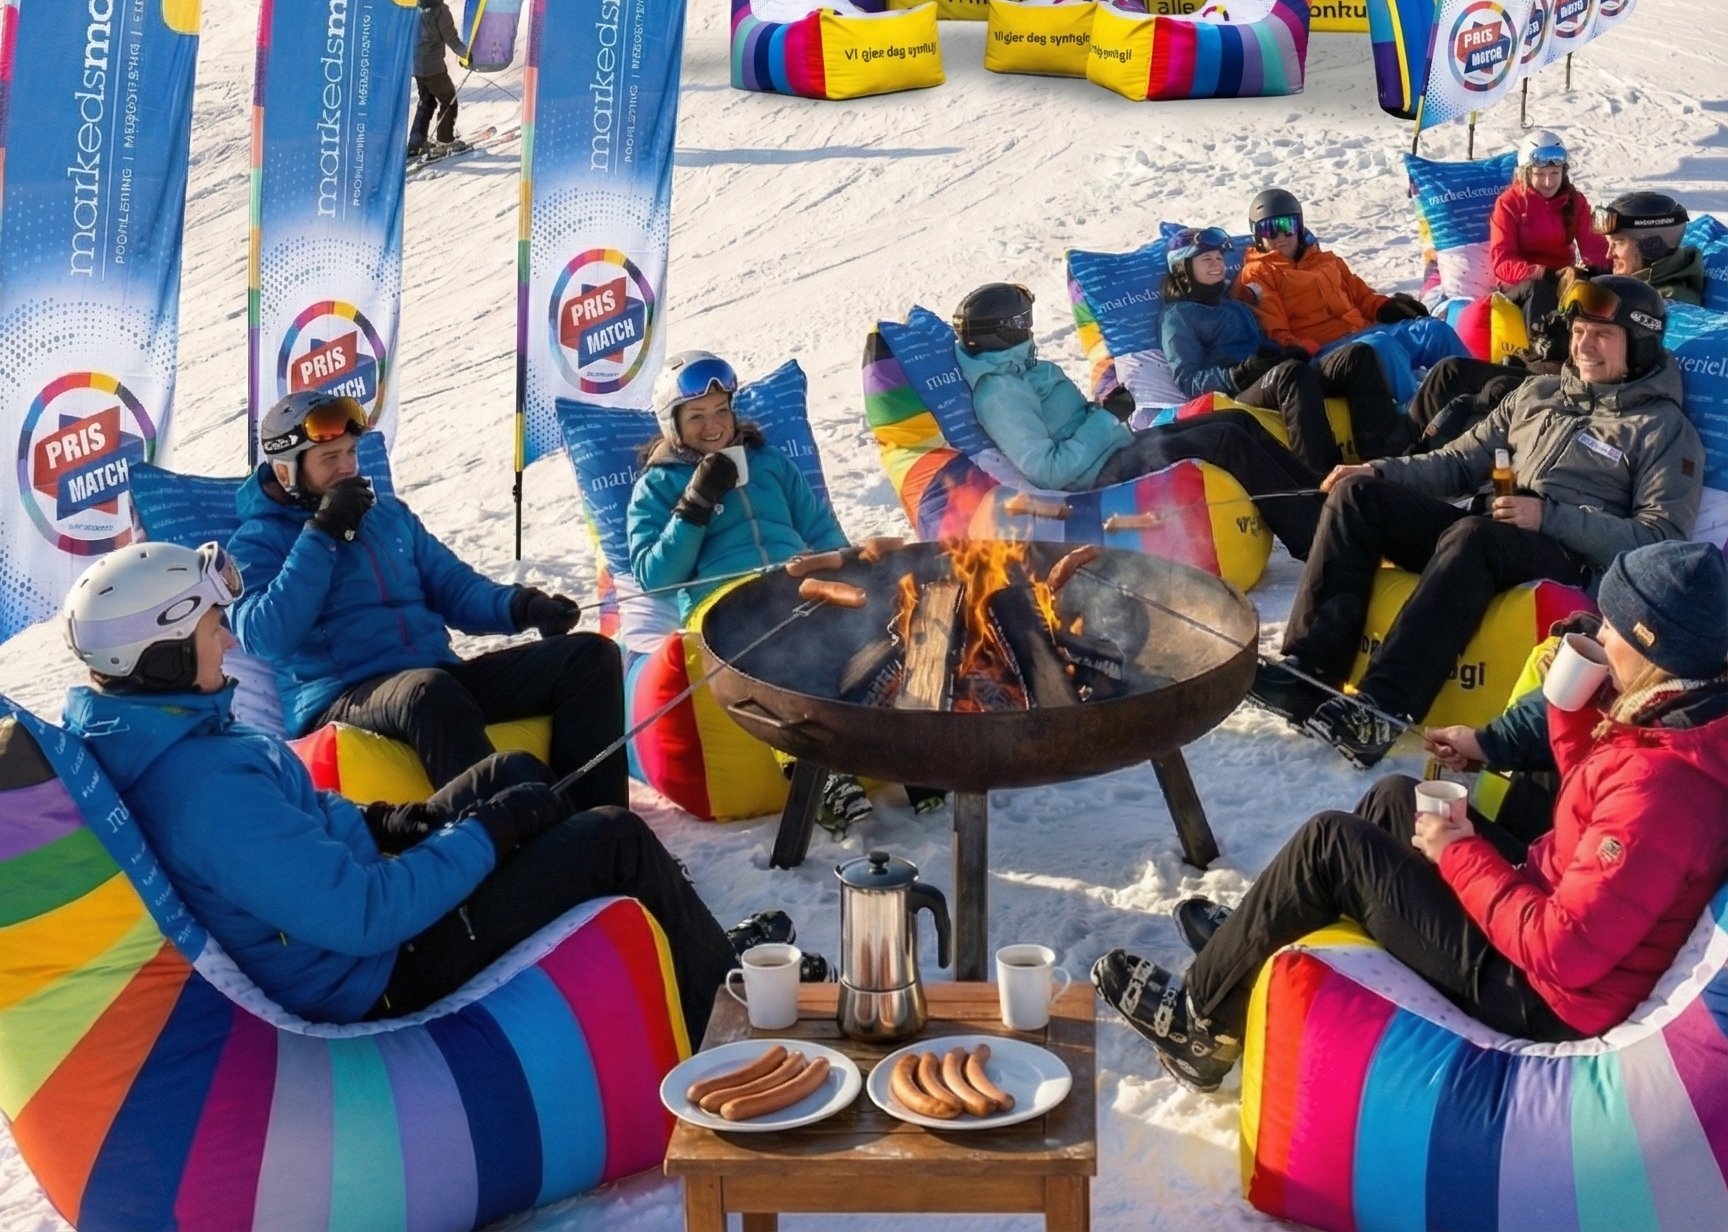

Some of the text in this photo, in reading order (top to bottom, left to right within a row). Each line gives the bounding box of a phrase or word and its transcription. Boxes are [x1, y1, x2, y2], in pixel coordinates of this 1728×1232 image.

[571, 289, 616, 326] PRIS
[586, 318, 635, 355] MATCH
[300, 346, 347, 385] PRIS
[45, 422, 106, 470] PRIS
[67, 457, 129, 504] MATCH
